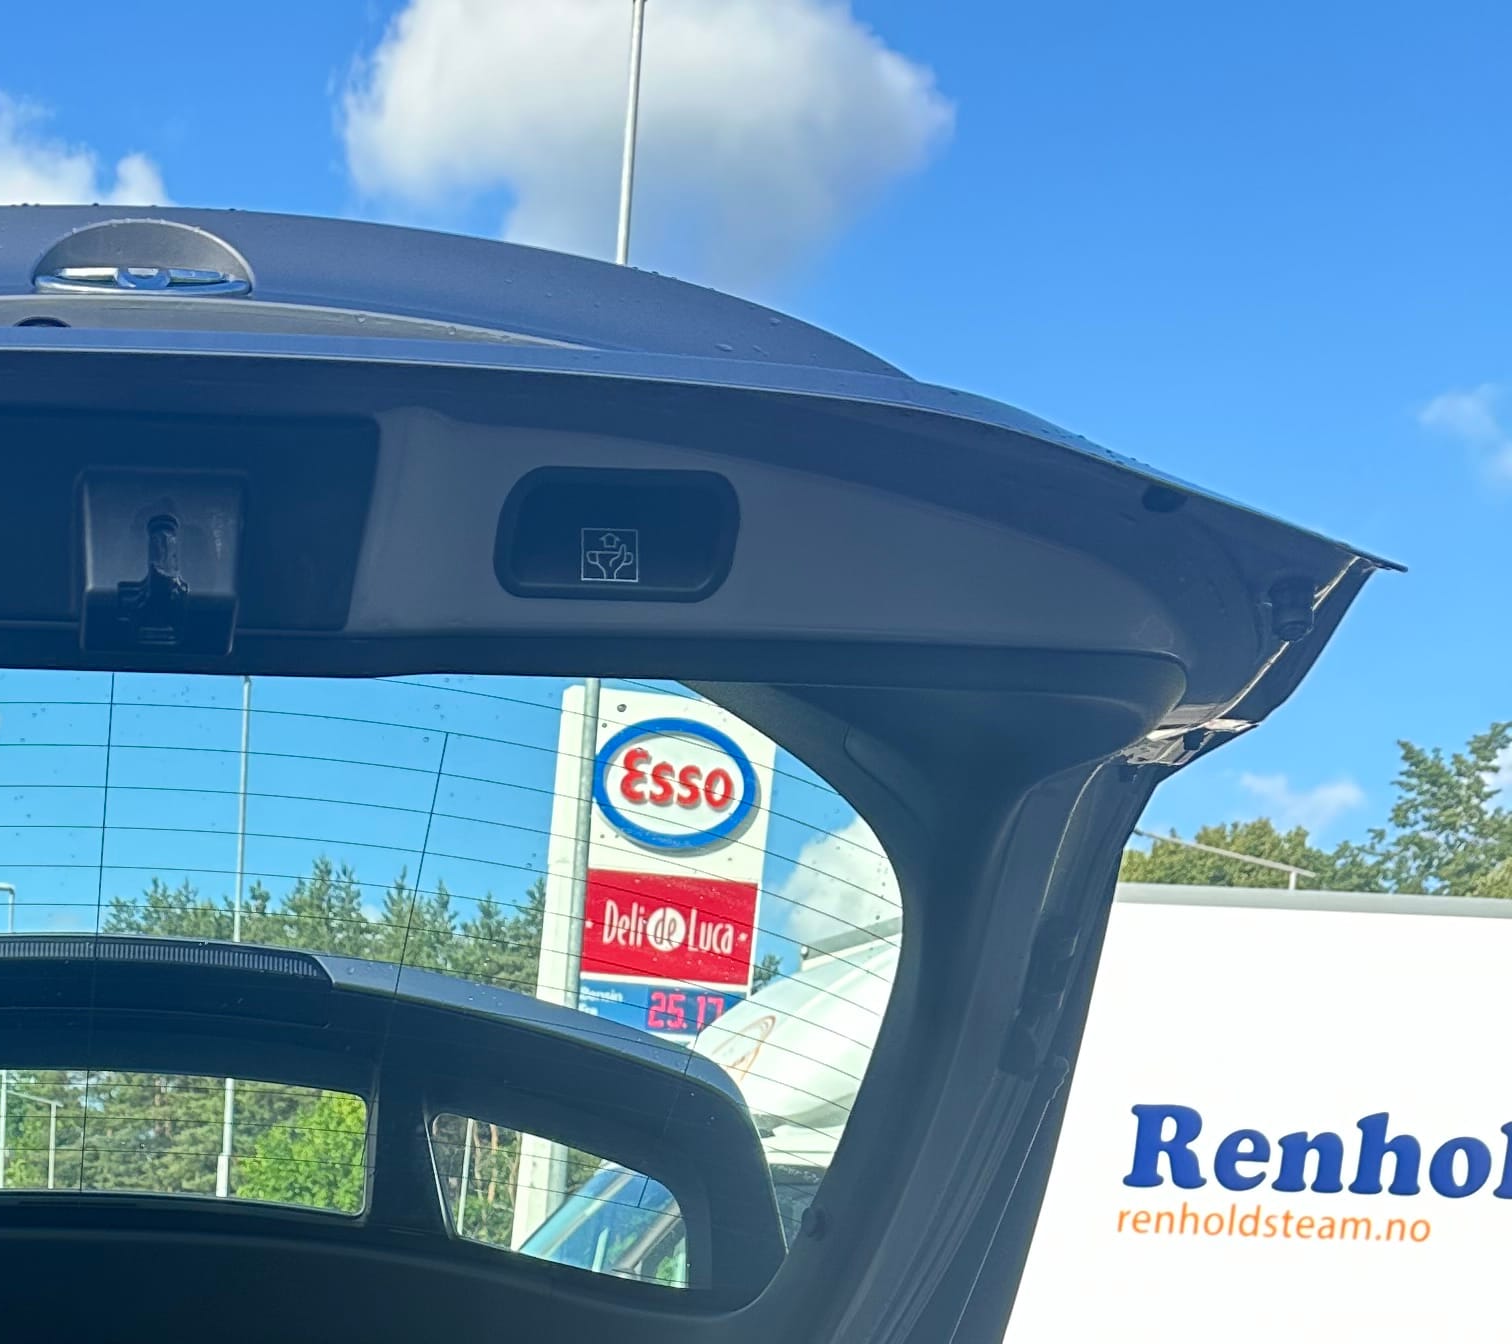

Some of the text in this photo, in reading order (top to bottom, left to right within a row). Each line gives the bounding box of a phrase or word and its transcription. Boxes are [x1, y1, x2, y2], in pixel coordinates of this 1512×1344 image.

[603, 900, 644, 947] Deli
[688, 911, 734, 955] Luca
[1117, 1202, 1431, 1242] renholdsteam.no
